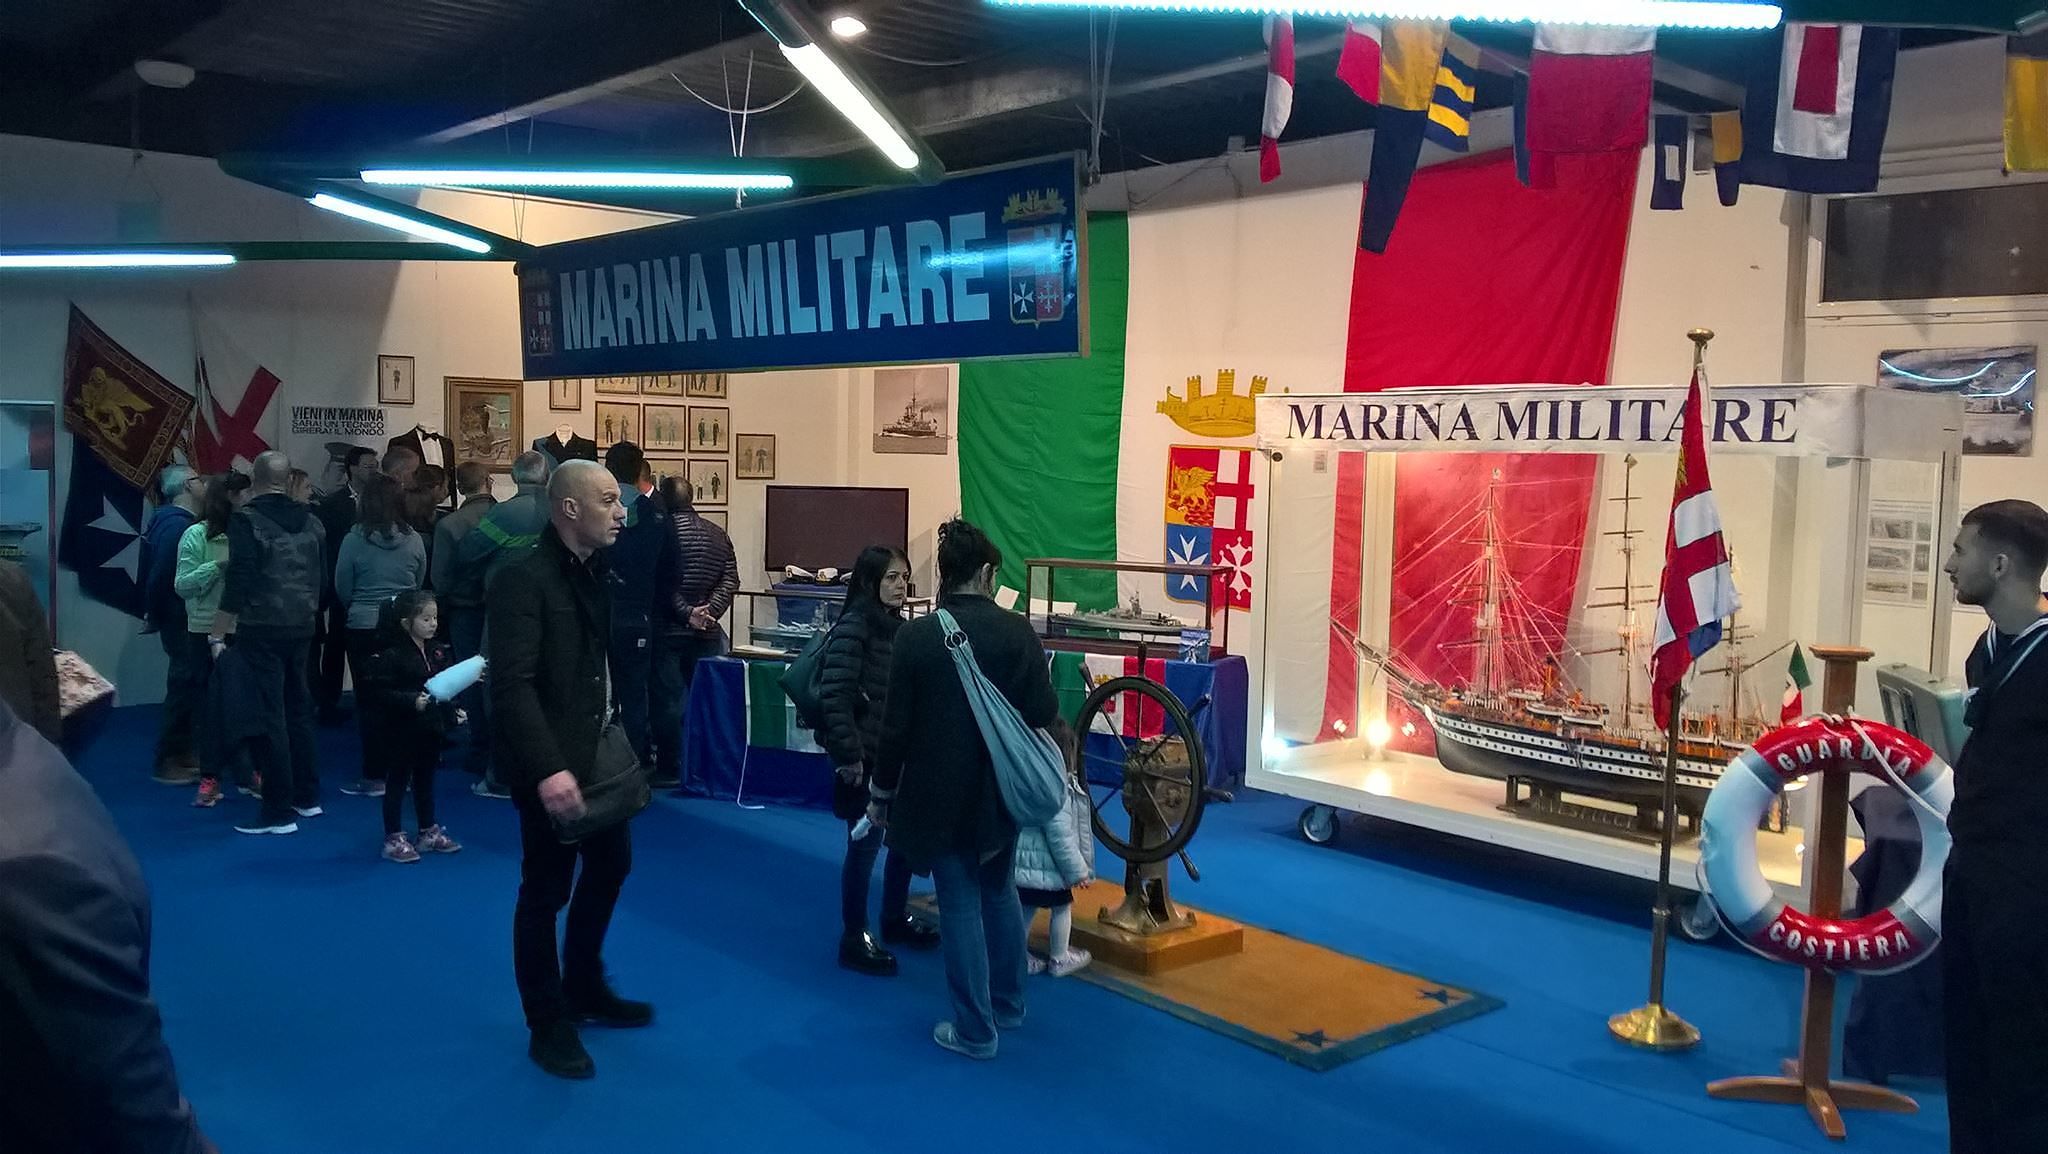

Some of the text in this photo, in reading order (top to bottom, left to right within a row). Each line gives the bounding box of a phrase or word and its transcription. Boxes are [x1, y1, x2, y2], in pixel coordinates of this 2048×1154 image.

[559, 211, 990, 350] MARINA MILITARE
[292, 406, 384, 422] VIENI IN MARINA
[341, 421, 385, 429] TECNICO
[344, 428, 385, 436] MONDO
[1286, 402, 1480, 441] MARINA
[1777, 737, 1911, 776] GUARDIA
[1768, 920, 1911, 961] COSTIERA
